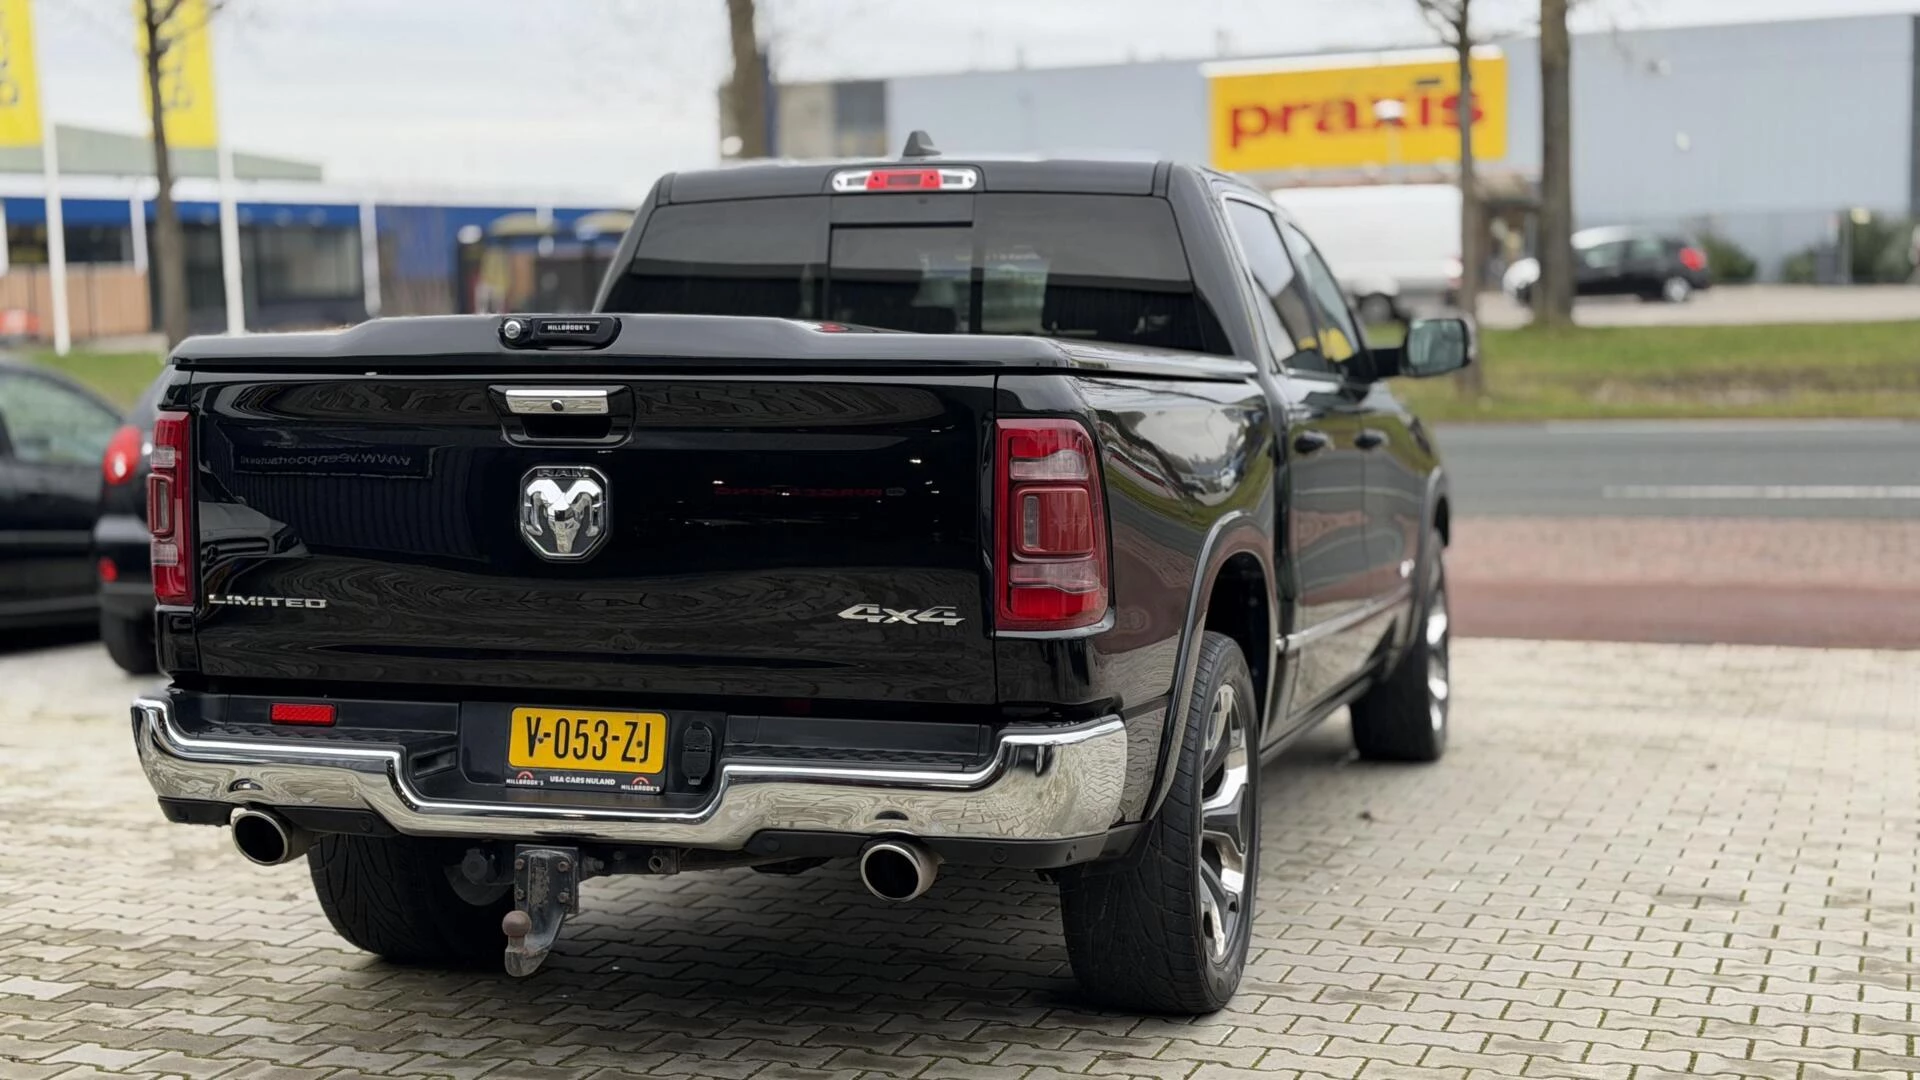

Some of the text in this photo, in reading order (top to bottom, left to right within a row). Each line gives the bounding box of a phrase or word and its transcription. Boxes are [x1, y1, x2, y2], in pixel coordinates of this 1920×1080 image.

[537, 467, 590, 478] RAM
[207, 593, 328, 609] LIMITED
[837, 603, 966, 627] 4x4
[526, 716, 652, 764] V-053-ZJ
[505, 778, 545, 787] MILLBROOK'S
[549, 775, 617, 786] USA CARS NULAND
[620, 783, 661, 793] MILLBROOK'S
